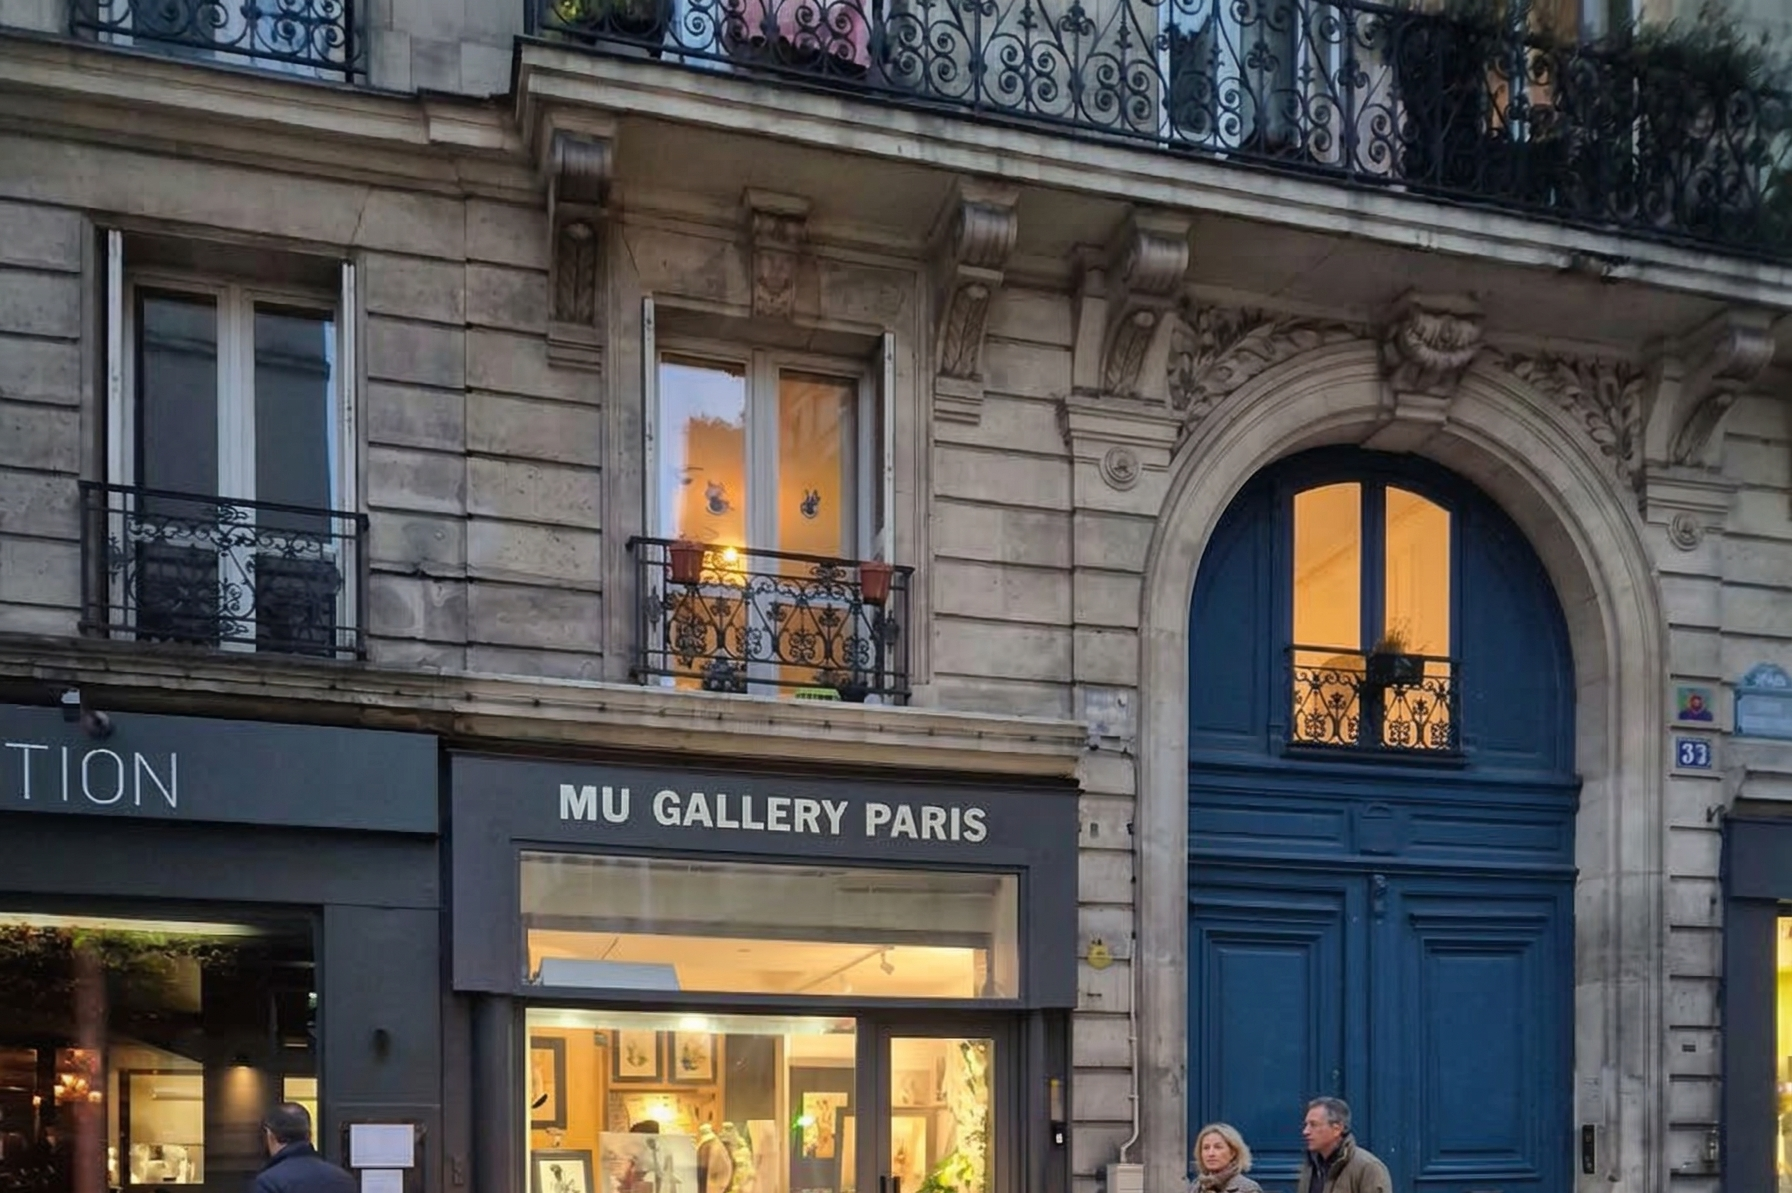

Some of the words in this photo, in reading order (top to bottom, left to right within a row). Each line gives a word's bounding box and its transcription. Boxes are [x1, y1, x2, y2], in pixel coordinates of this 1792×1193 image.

[5, 742, 177, 808] TION
[560, 784, 630, 823] MU
[653, 790, 848, 835] GALLERY
[866, 802, 987, 842] PARIS
